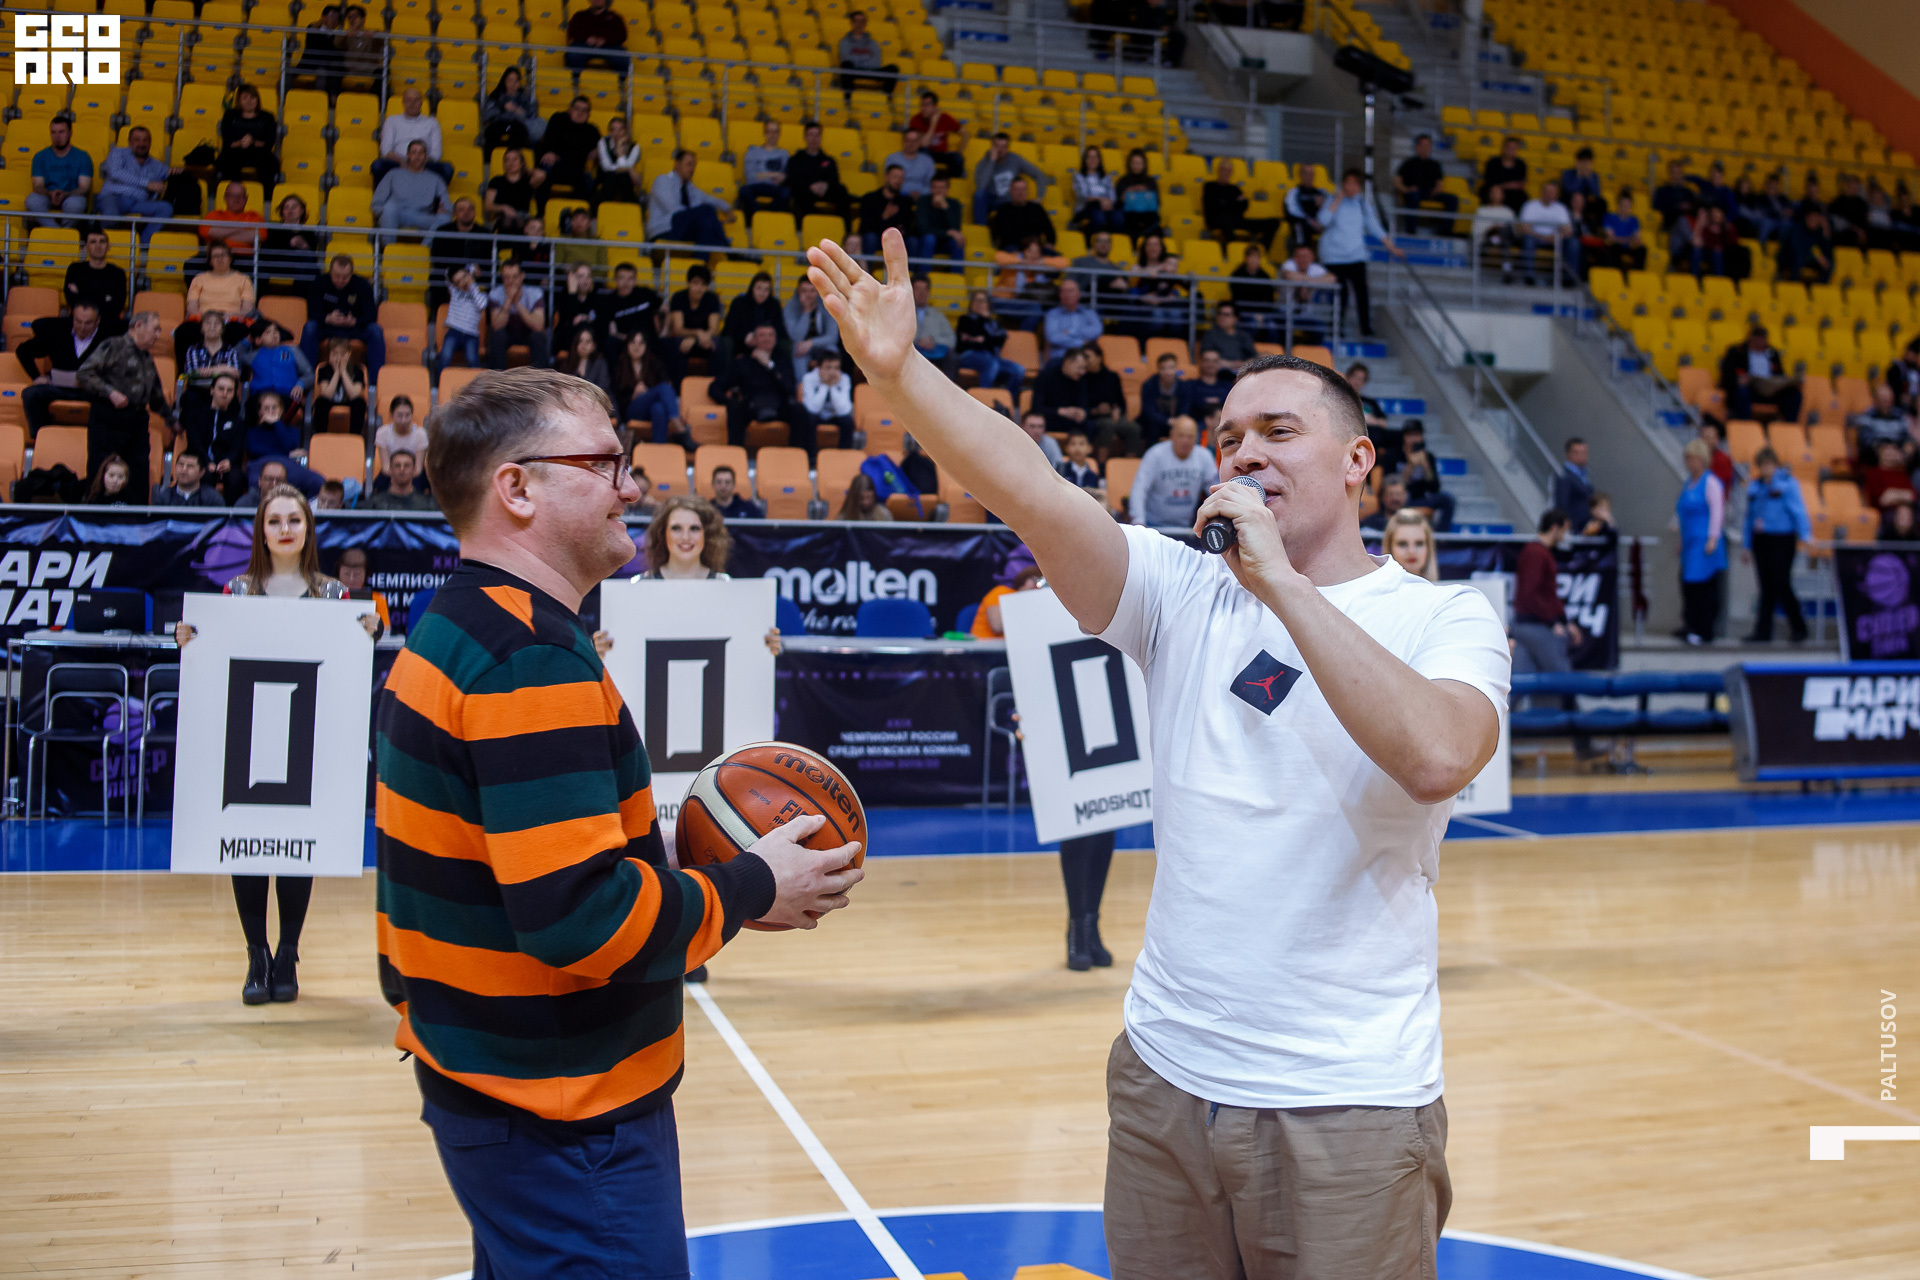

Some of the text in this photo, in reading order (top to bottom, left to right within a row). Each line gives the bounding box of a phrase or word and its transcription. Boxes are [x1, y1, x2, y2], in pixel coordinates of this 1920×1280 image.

[764, 561, 938, 606] molten
[773, 752, 861, 834] molten
[1074, 788, 1153, 826] MADSHOT
[220, 837, 317, 863] MADSHOT
